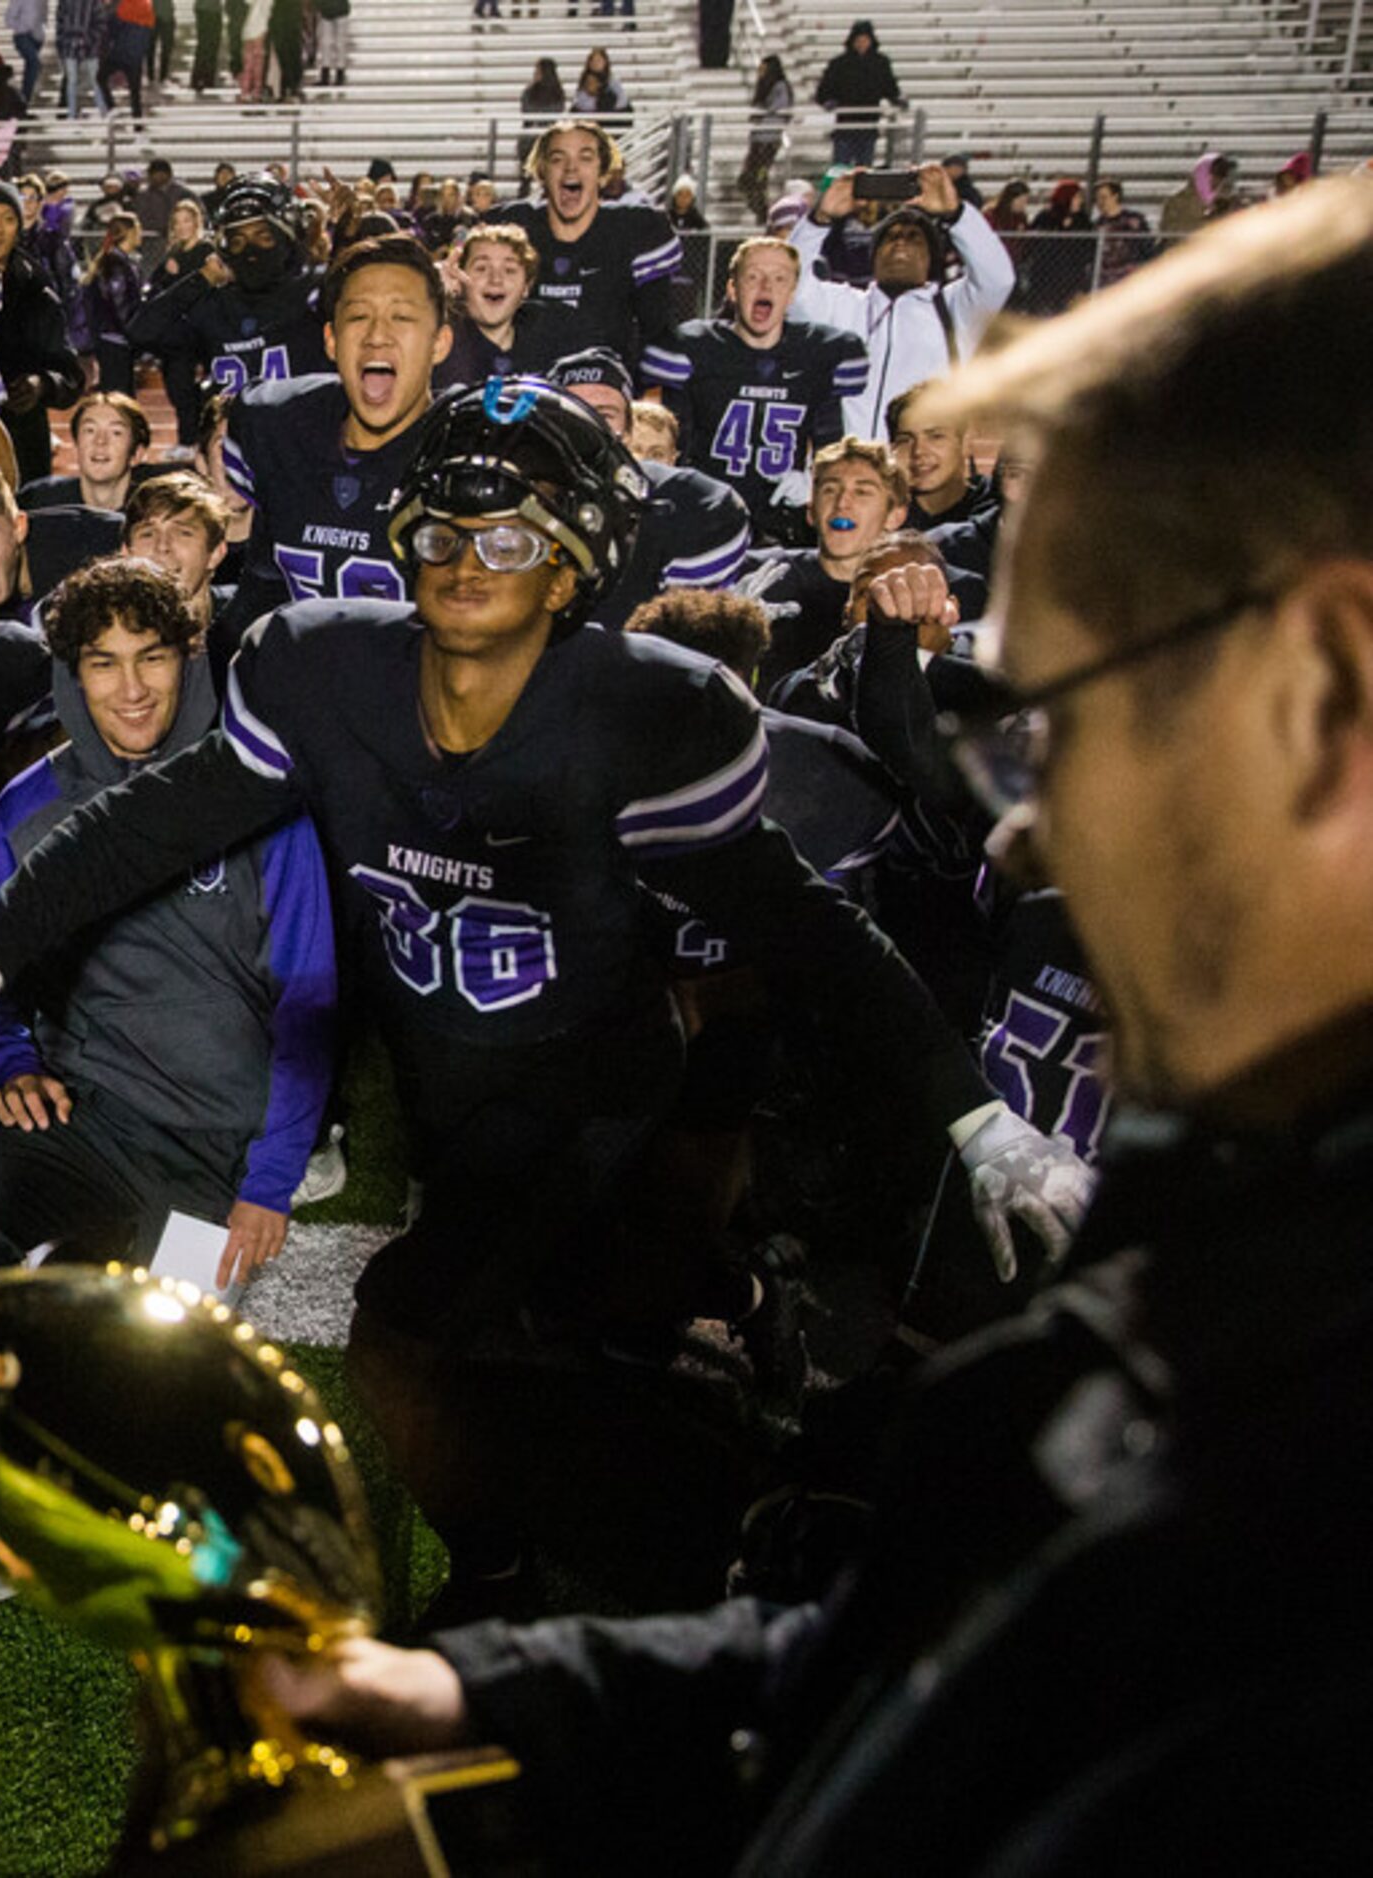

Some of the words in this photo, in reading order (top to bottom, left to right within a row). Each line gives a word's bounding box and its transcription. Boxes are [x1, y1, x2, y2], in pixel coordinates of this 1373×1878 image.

[711, 400, 807, 482] 45
[302, 524, 370, 551] KNIGHTS
[386, 843, 494, 892] KNIGHTS
